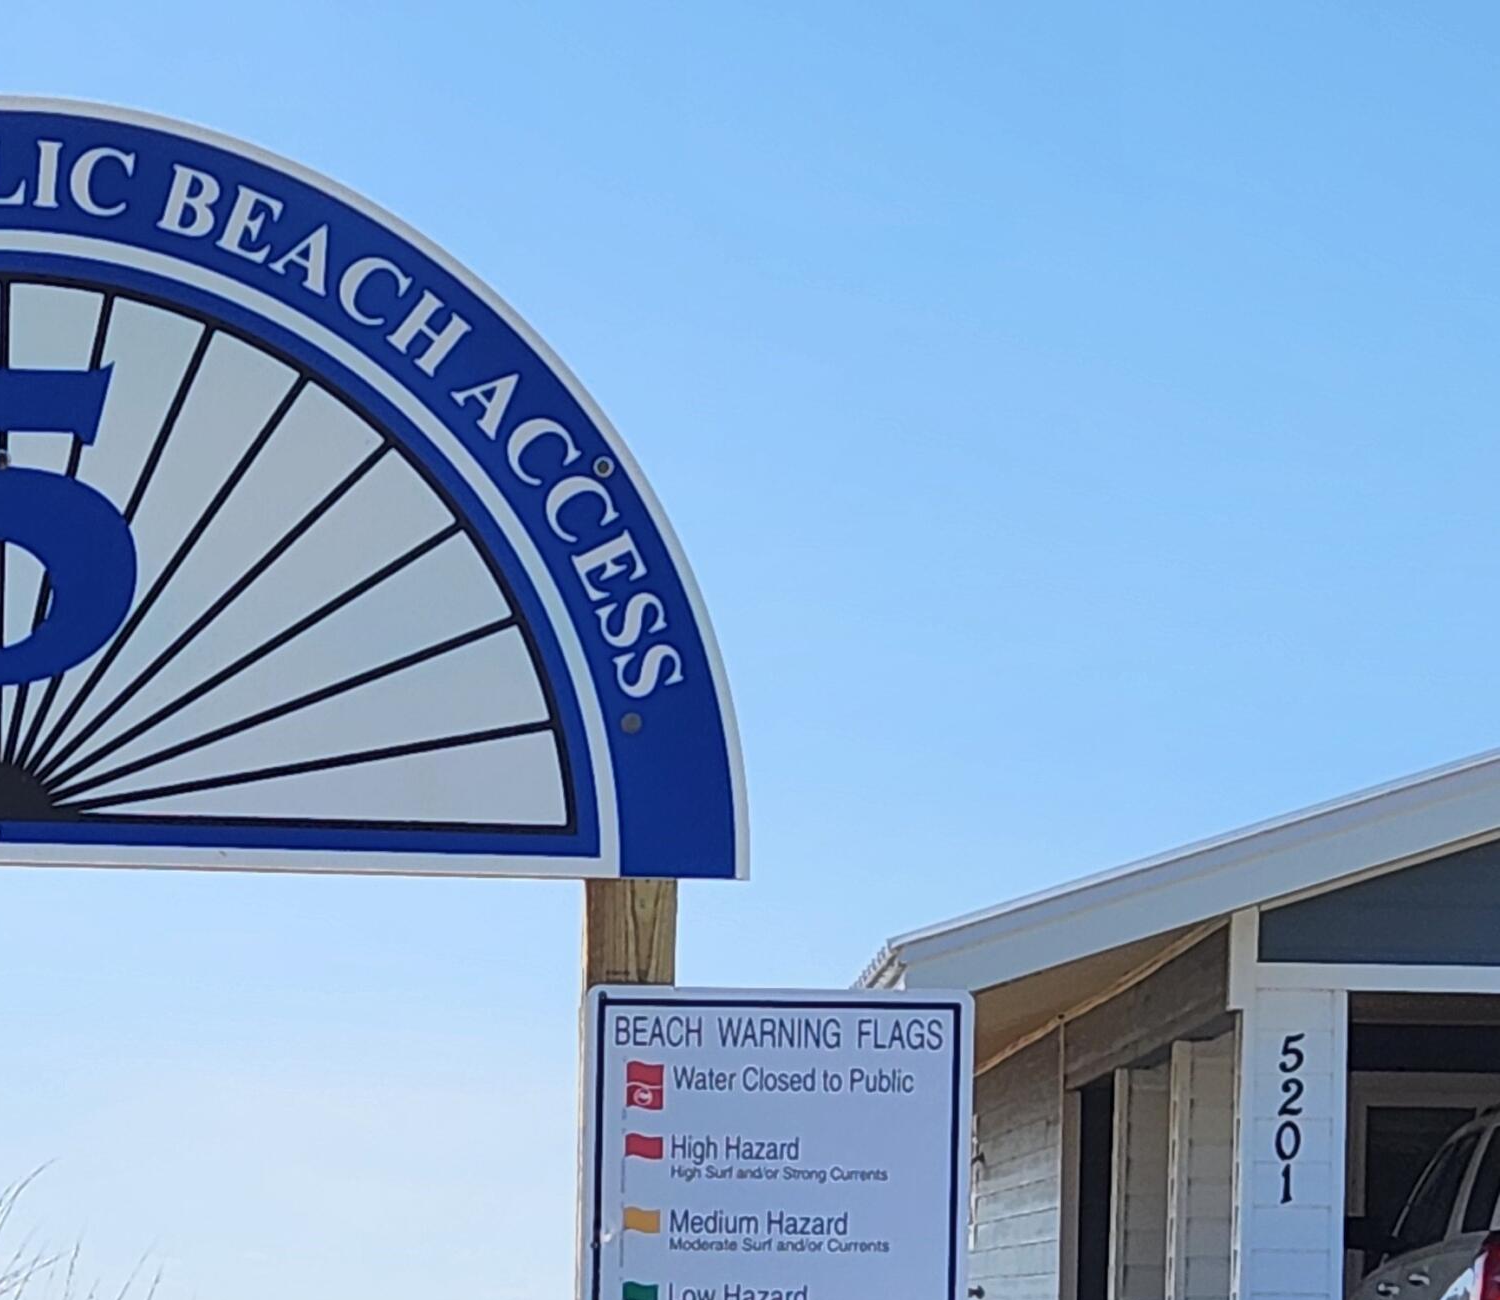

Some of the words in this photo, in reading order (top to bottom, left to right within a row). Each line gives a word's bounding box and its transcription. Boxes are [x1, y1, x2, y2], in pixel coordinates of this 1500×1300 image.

[157, 163, 473, 379] BEACH
[451, 371, 684, 699] ACCESS
[614, 1016, 702, 1047] BEACH
[717, 1017, 841, 1049] WARNING
[858, 1018, 944, 1050] FLAGS
[673, 1065, 737, 1091] Water
[742, 1066, 816, 1093] Closed
[823, 1070, 842, 1093] to
[850, 1068, 914, 1094] Public
[1275, 1033, 1305, 1204] 5201
[671, 1135, 718, 1165] High
[725, 1136, 801, 1161] Hazard
[671, 1165, 701, 1182] High
[705, 1165, 734, 1180] Surf
[736, 1166, 780, 1180] and/or
[783, 1166, 827, 1184] Strong
[830, 1167, 888, 1182] Currents
[669, 1209, 759, 1234] Medium
[767, 1210, 848, 1236] Hazard
[669, 1238, 738, 1252] Moderate
[742, 1238, 774, 1252] Surf
[777, 1238, 823, 1253] and/or
[827, 1239, 890, 1253] Currents
